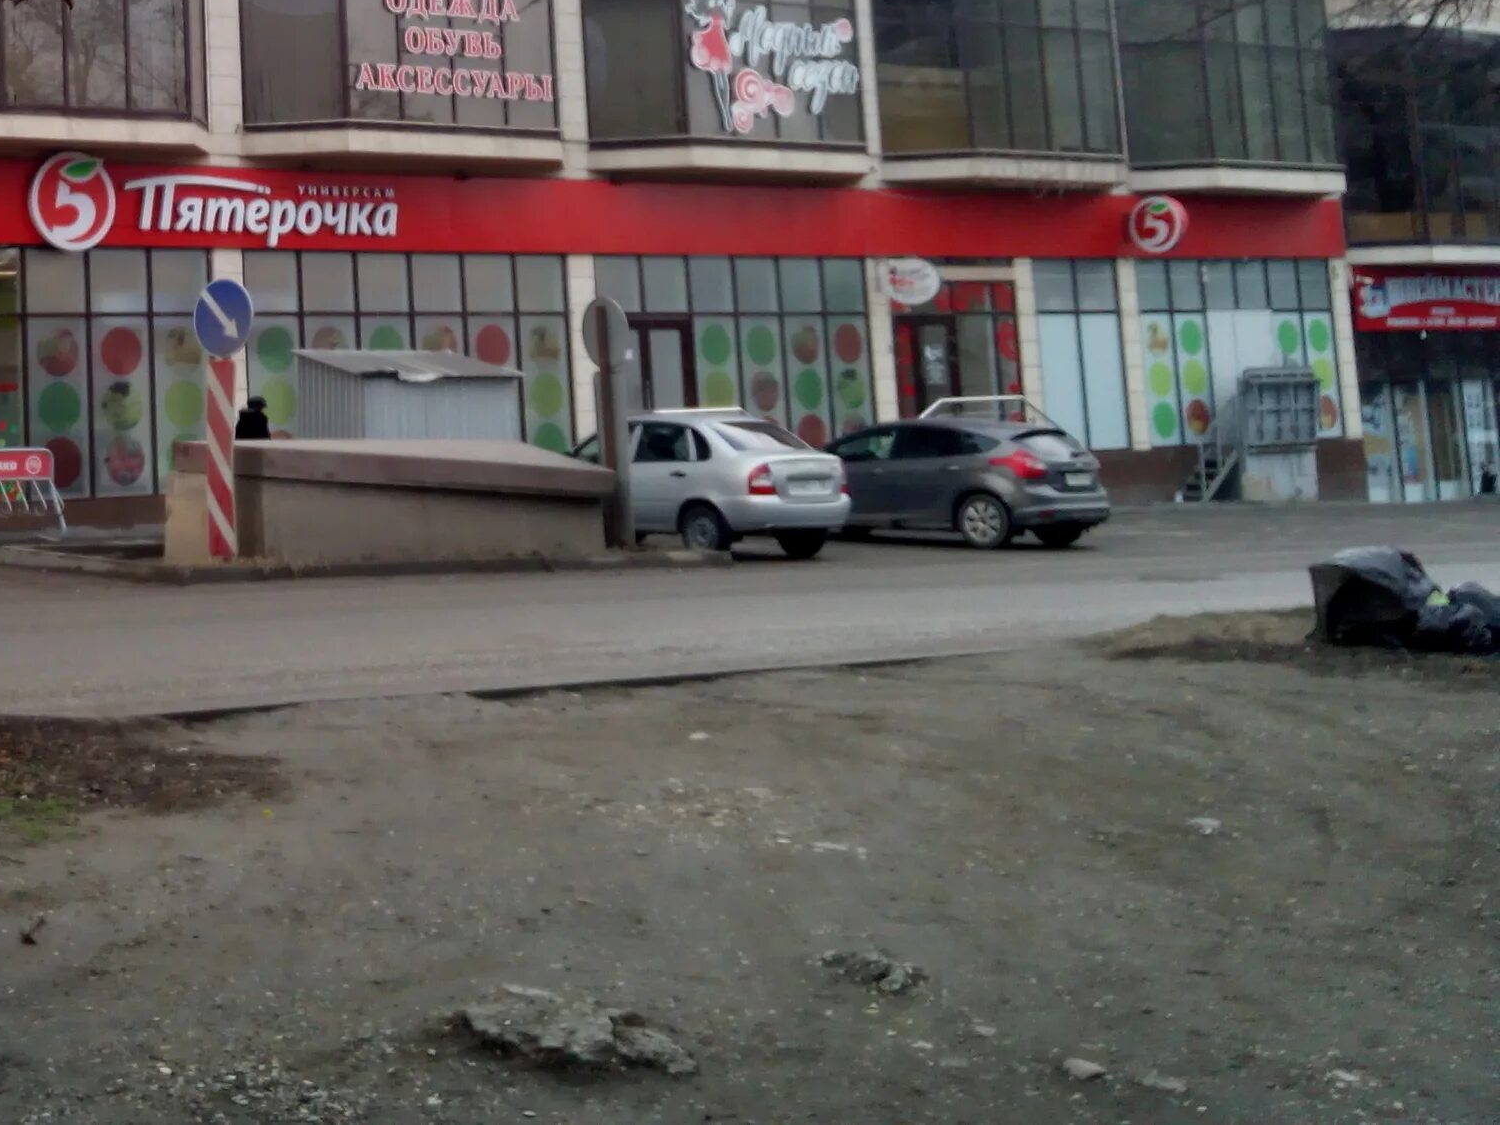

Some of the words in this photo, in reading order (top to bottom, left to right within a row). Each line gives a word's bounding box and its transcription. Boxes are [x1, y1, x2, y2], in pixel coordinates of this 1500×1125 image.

[404, 26, 502, 59] ОБУВЬ
[356, 62, 554, 102] АКСЕССУАРЫ
[297, 184, 396, 198] УНИВЕРСАМ
[124, 175, 399, 248] Пятёрочка
